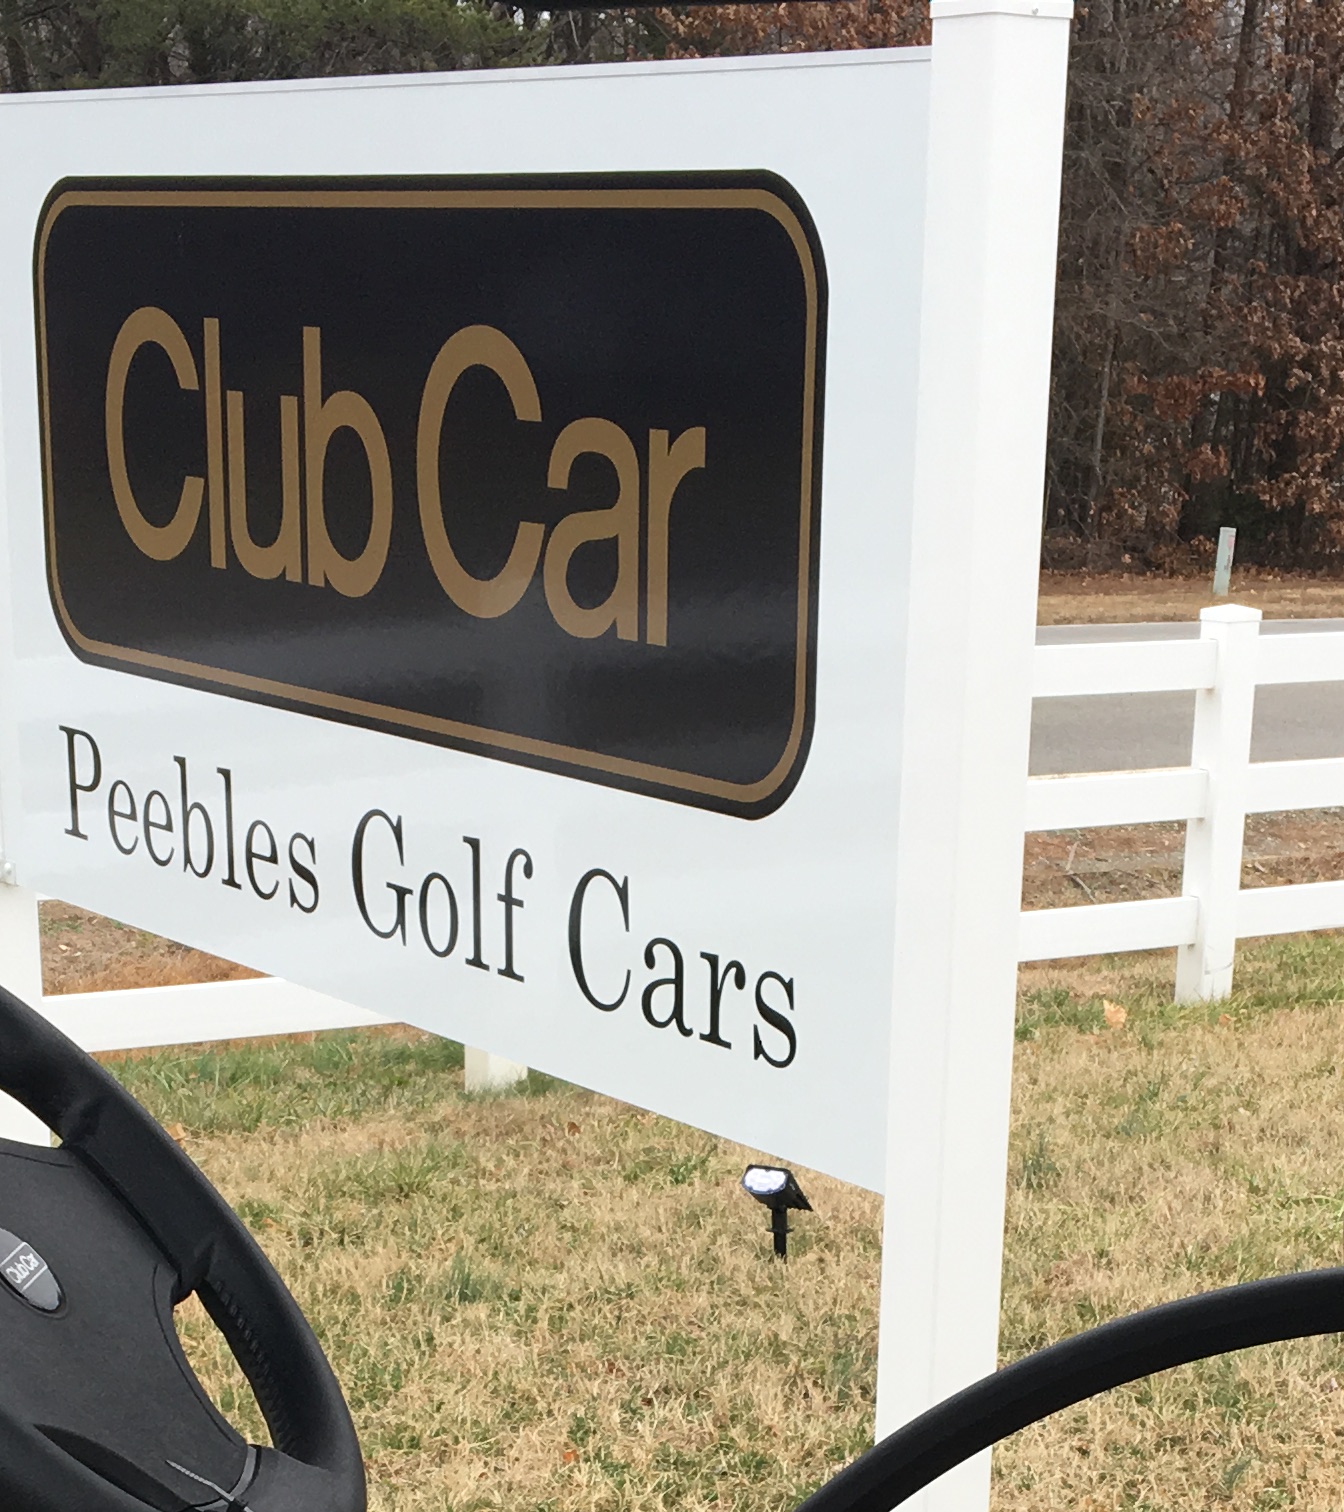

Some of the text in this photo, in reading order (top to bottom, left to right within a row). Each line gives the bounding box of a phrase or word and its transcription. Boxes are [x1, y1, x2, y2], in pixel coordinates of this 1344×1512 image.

[105, 305, 706, 647] Club Car
[58, 725, 799, 1070] Peebles Golf Cars
